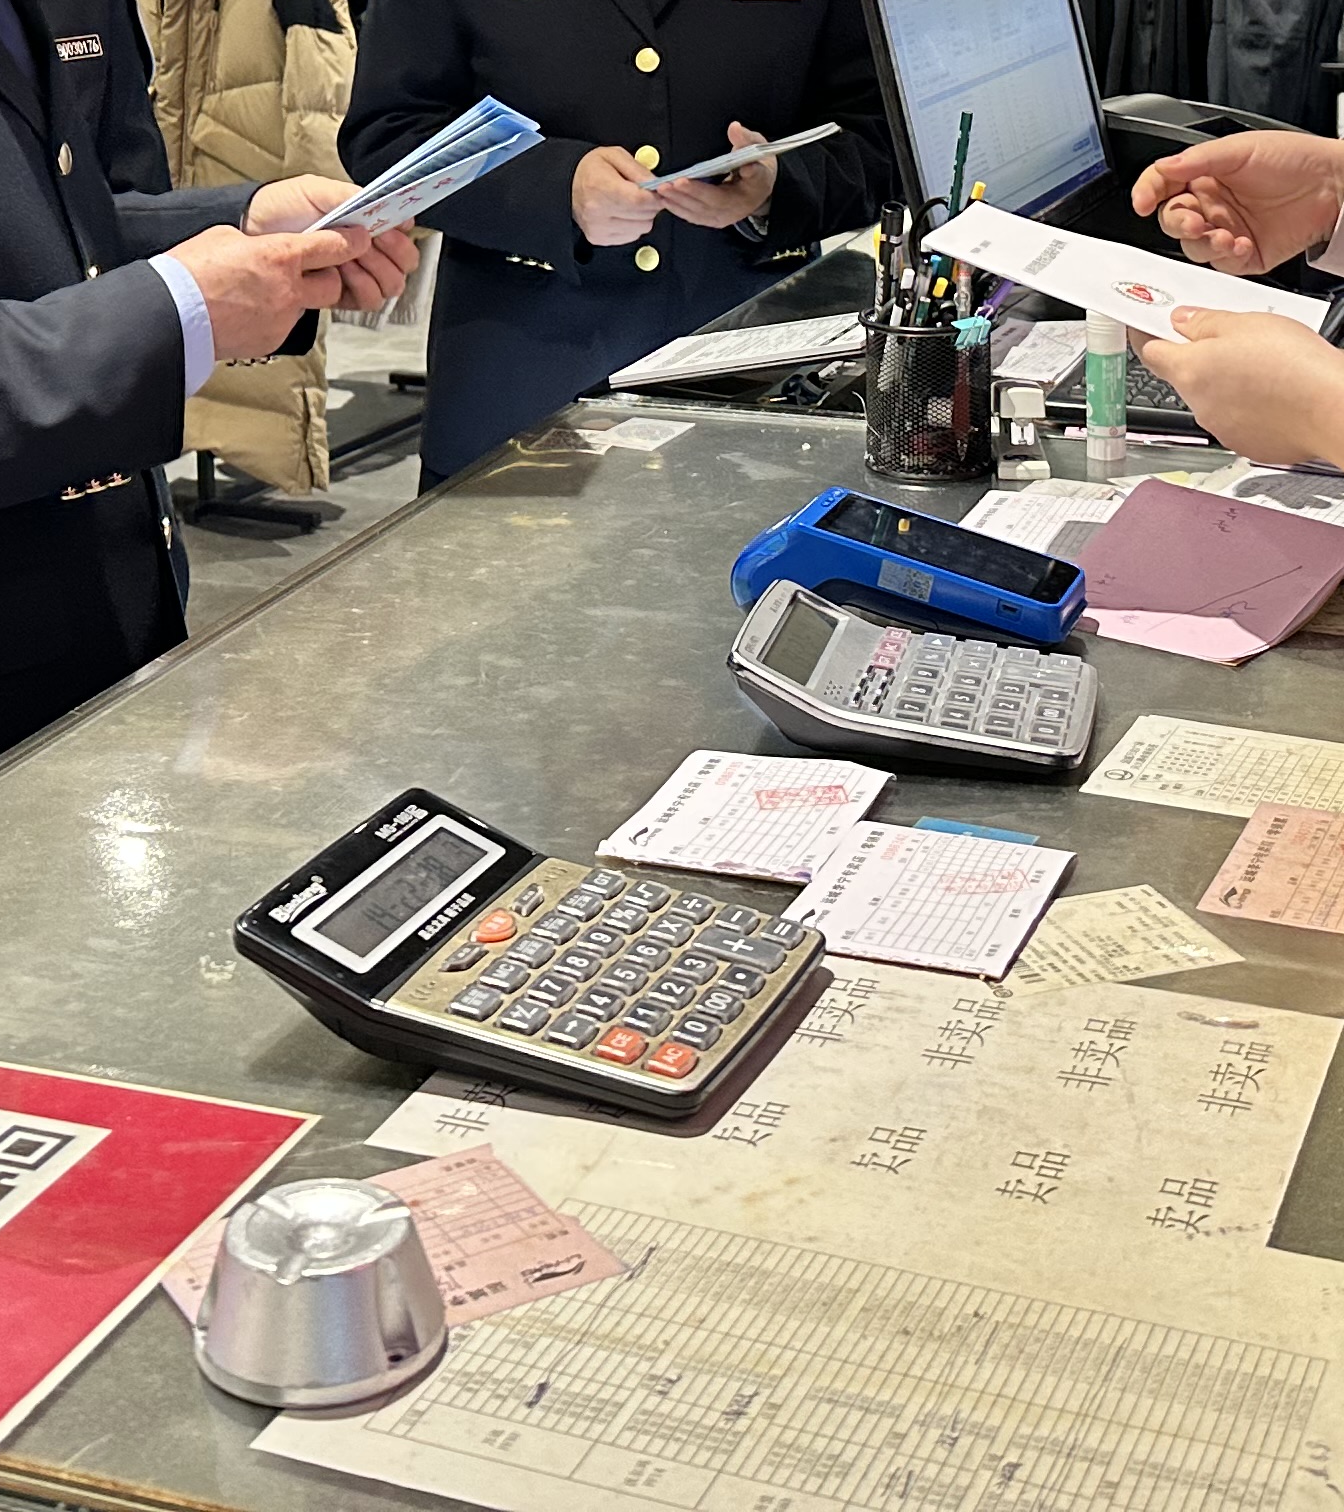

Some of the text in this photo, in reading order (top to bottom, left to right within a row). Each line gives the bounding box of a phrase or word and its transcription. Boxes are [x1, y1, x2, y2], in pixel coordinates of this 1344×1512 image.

[540, 978, 562, 992] 7
[566, 955, 590, 968] 8
[590, 931, 612, 944] 9
[590, 944, 659, 1006] 4 5 6
[635, 1007, 657, 1020] 1
[660, 981, 685, 995] 2
[684, 958, 707, 970] 3
[662, 1046, 684, 1064] AC
[684, 1020, 707, 1034] 0
[795, 976, 881, 1048] 非卖品
[920, 997, 1007, 1070] 非卖品
[1056, 1017, 1138, 1092] 非卖品
[1196, 1039, 1275, 1118] 非卖品
